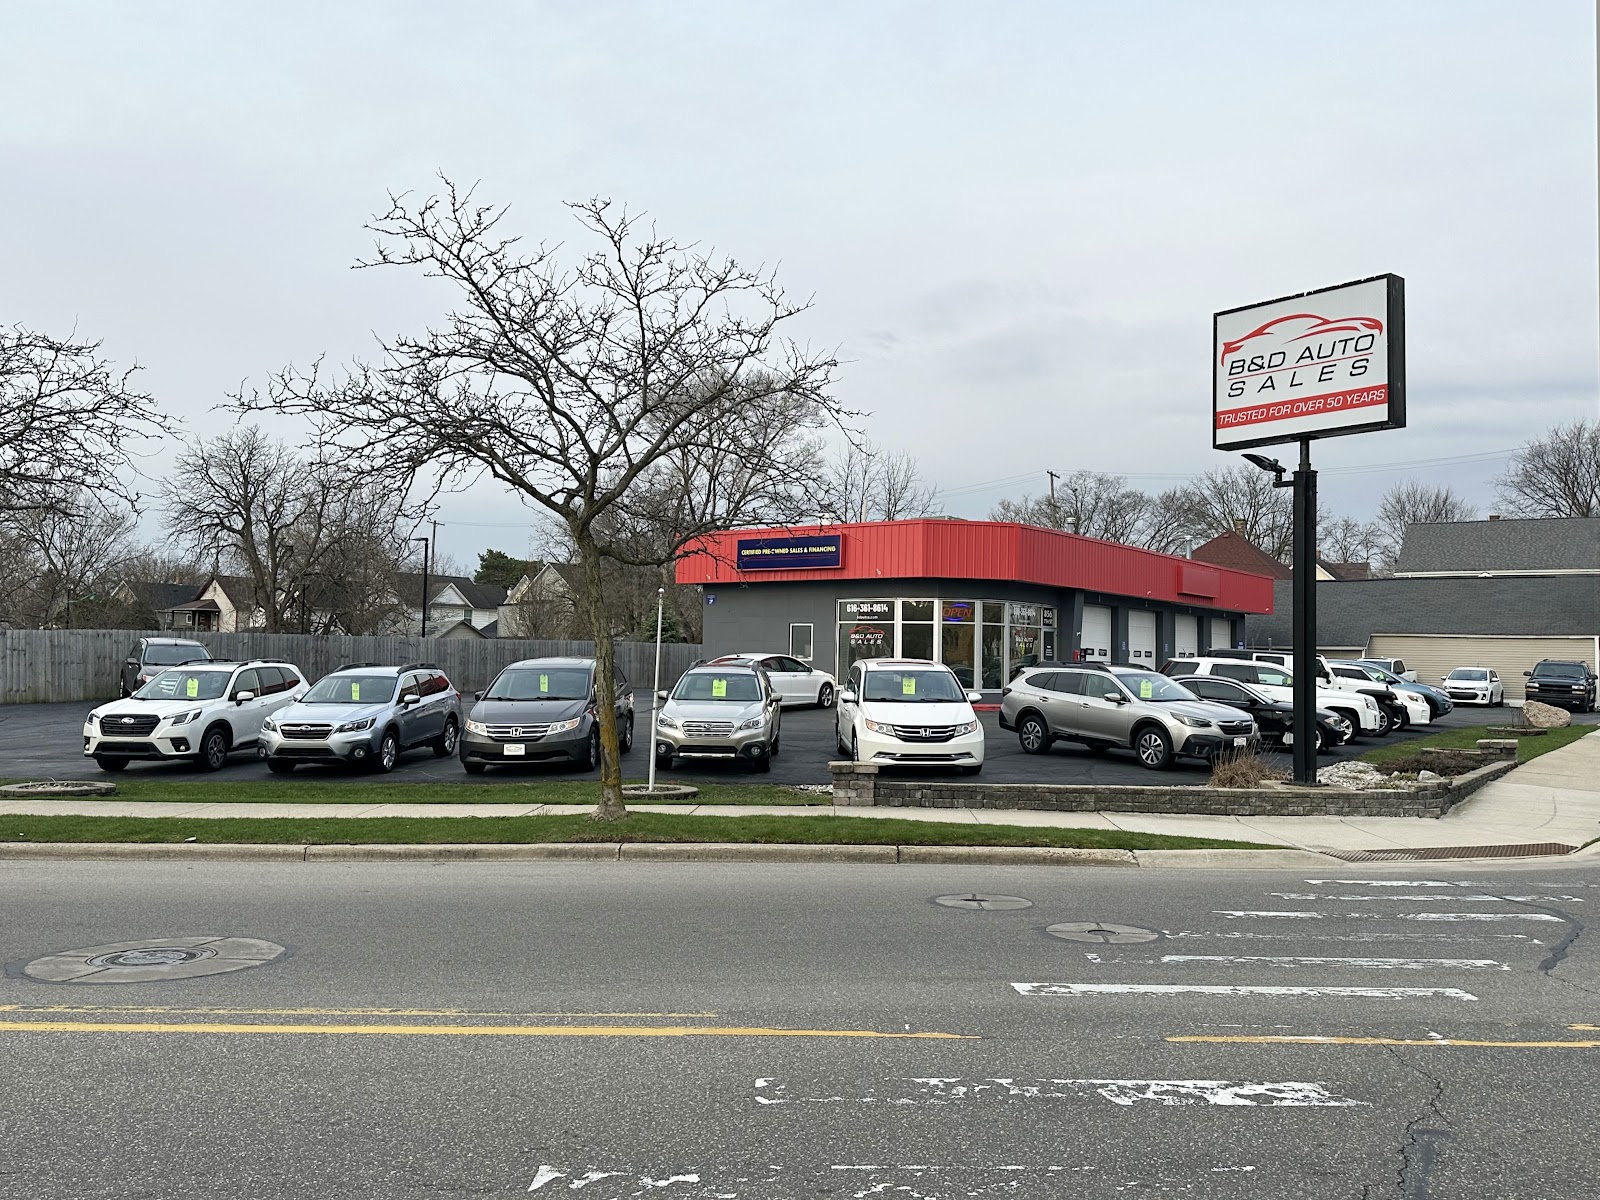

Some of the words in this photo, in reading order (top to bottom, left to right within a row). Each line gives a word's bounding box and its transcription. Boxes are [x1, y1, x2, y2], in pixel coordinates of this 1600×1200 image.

[1228, 352, 1285, 376] B&D
[1295, 333, 1375, 364] AUTO
[1228, 358, 1370, 398] SALES
[1219, 408, 1267, 425] TRUSTED
[1268, 404, 1291, 419] FOR
[1293, 399, 1324, 414] OVER
[1326, 396, 1343, 409] 50
[1346, 389, 1385, 405] YEARS
[943, 607, 972, 617] OPEN
